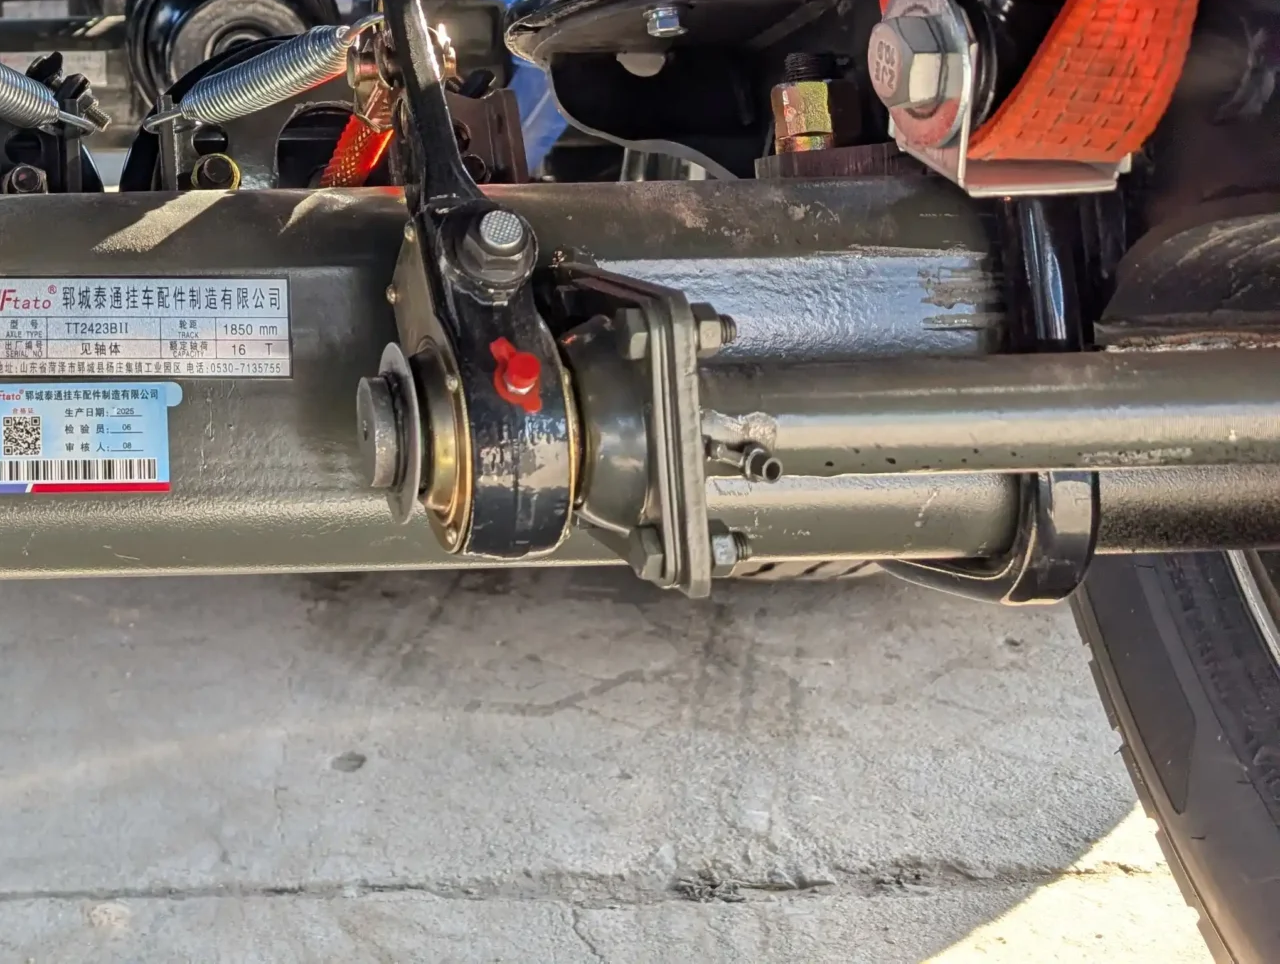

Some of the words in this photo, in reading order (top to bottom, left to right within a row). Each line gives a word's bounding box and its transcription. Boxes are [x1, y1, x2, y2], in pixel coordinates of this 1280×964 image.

[62, 285, 280, 311] 郓城泰通挂车配件制造有限公司
[178, 319, 198, 330] 轮距
[223, 323, 253, 336] 1850
[259, 325, 278, 336] mm
[5, 331, 22, 339] AXLE
[25, 331, 43, 339] TYPE
[177, 331, 199, 339] TRACK
[6, 350, 29, 358] SERIAL
[80, 342, 121, 356] 见轴体
[173, 350, 205, 358] CAPACITY
[231, 343, 246, 356] 16
[264, 343, 274, 356] T
[116, 407, 135, 416] 2025
